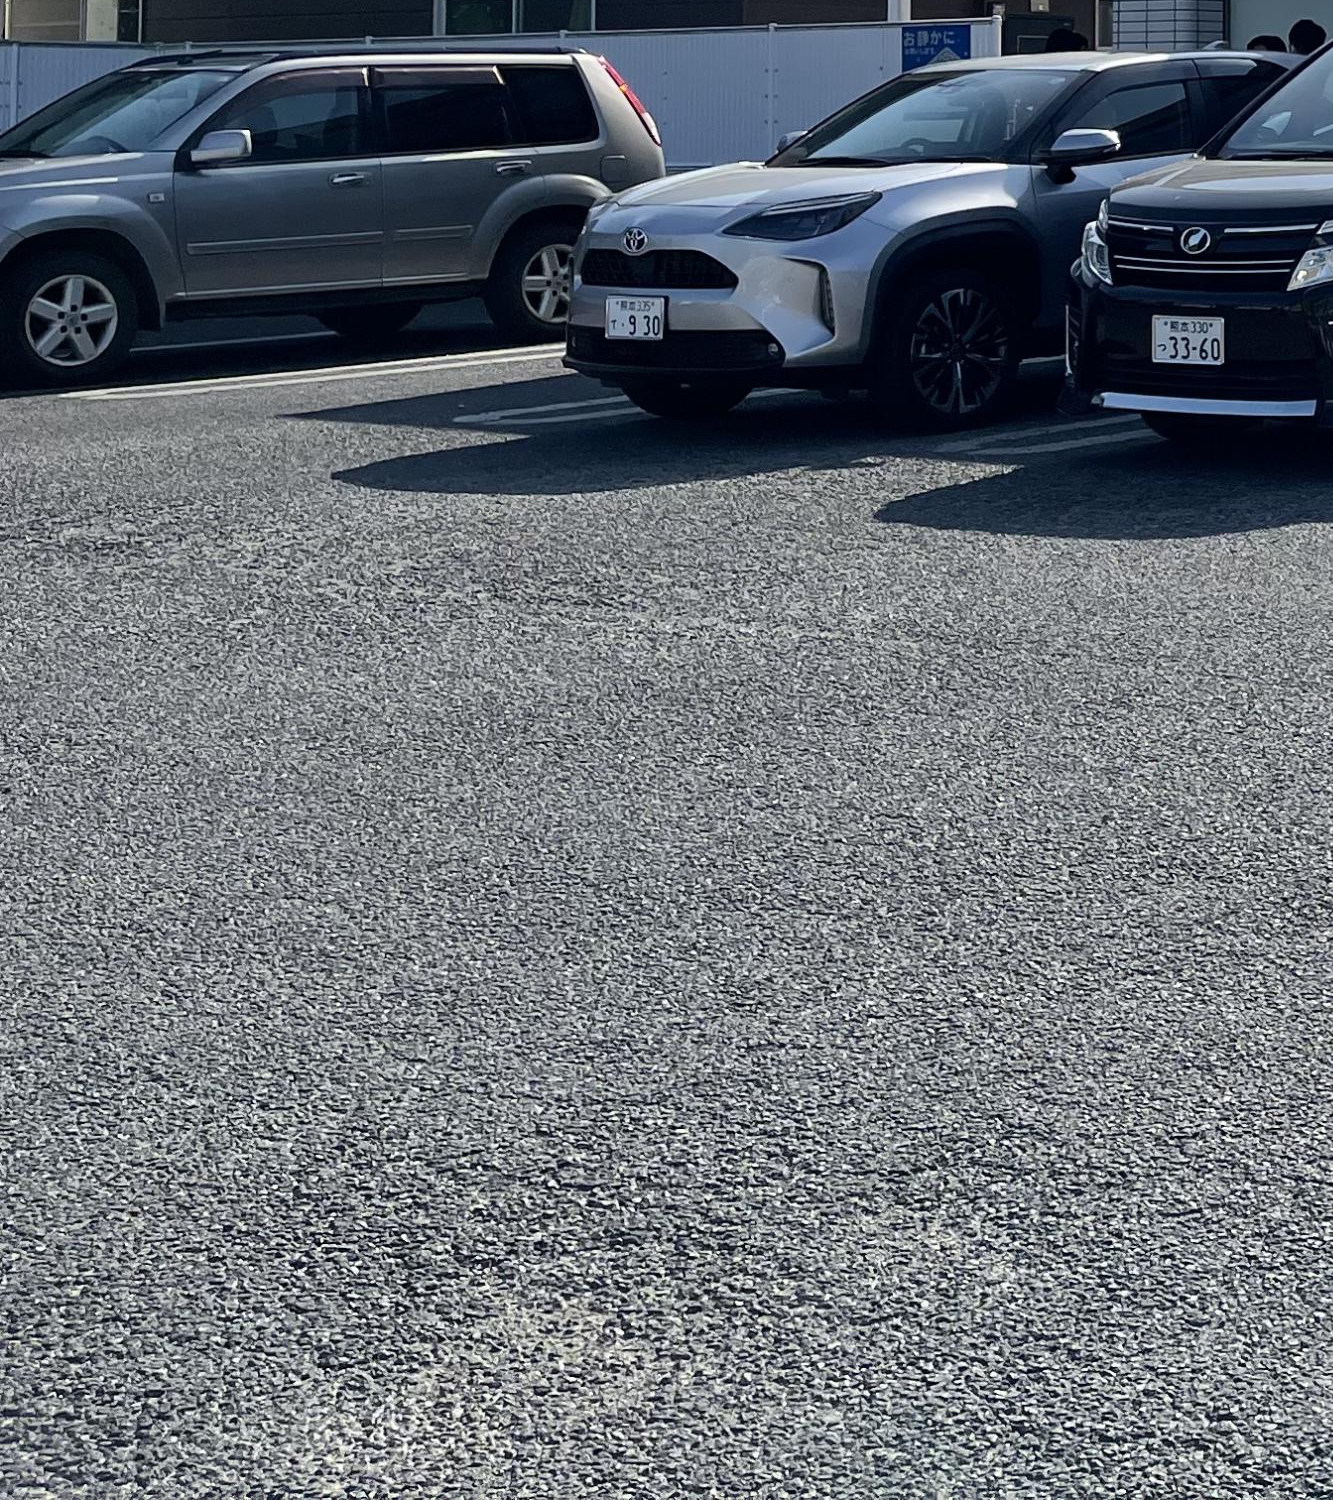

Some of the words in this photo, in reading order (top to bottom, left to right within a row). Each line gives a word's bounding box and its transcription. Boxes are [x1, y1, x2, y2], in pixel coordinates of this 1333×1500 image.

[903, 30, 955, 46] お静かに
[1157, 343, 1167, 352] つ
[1168, 336, 1221, 361] 33-60
